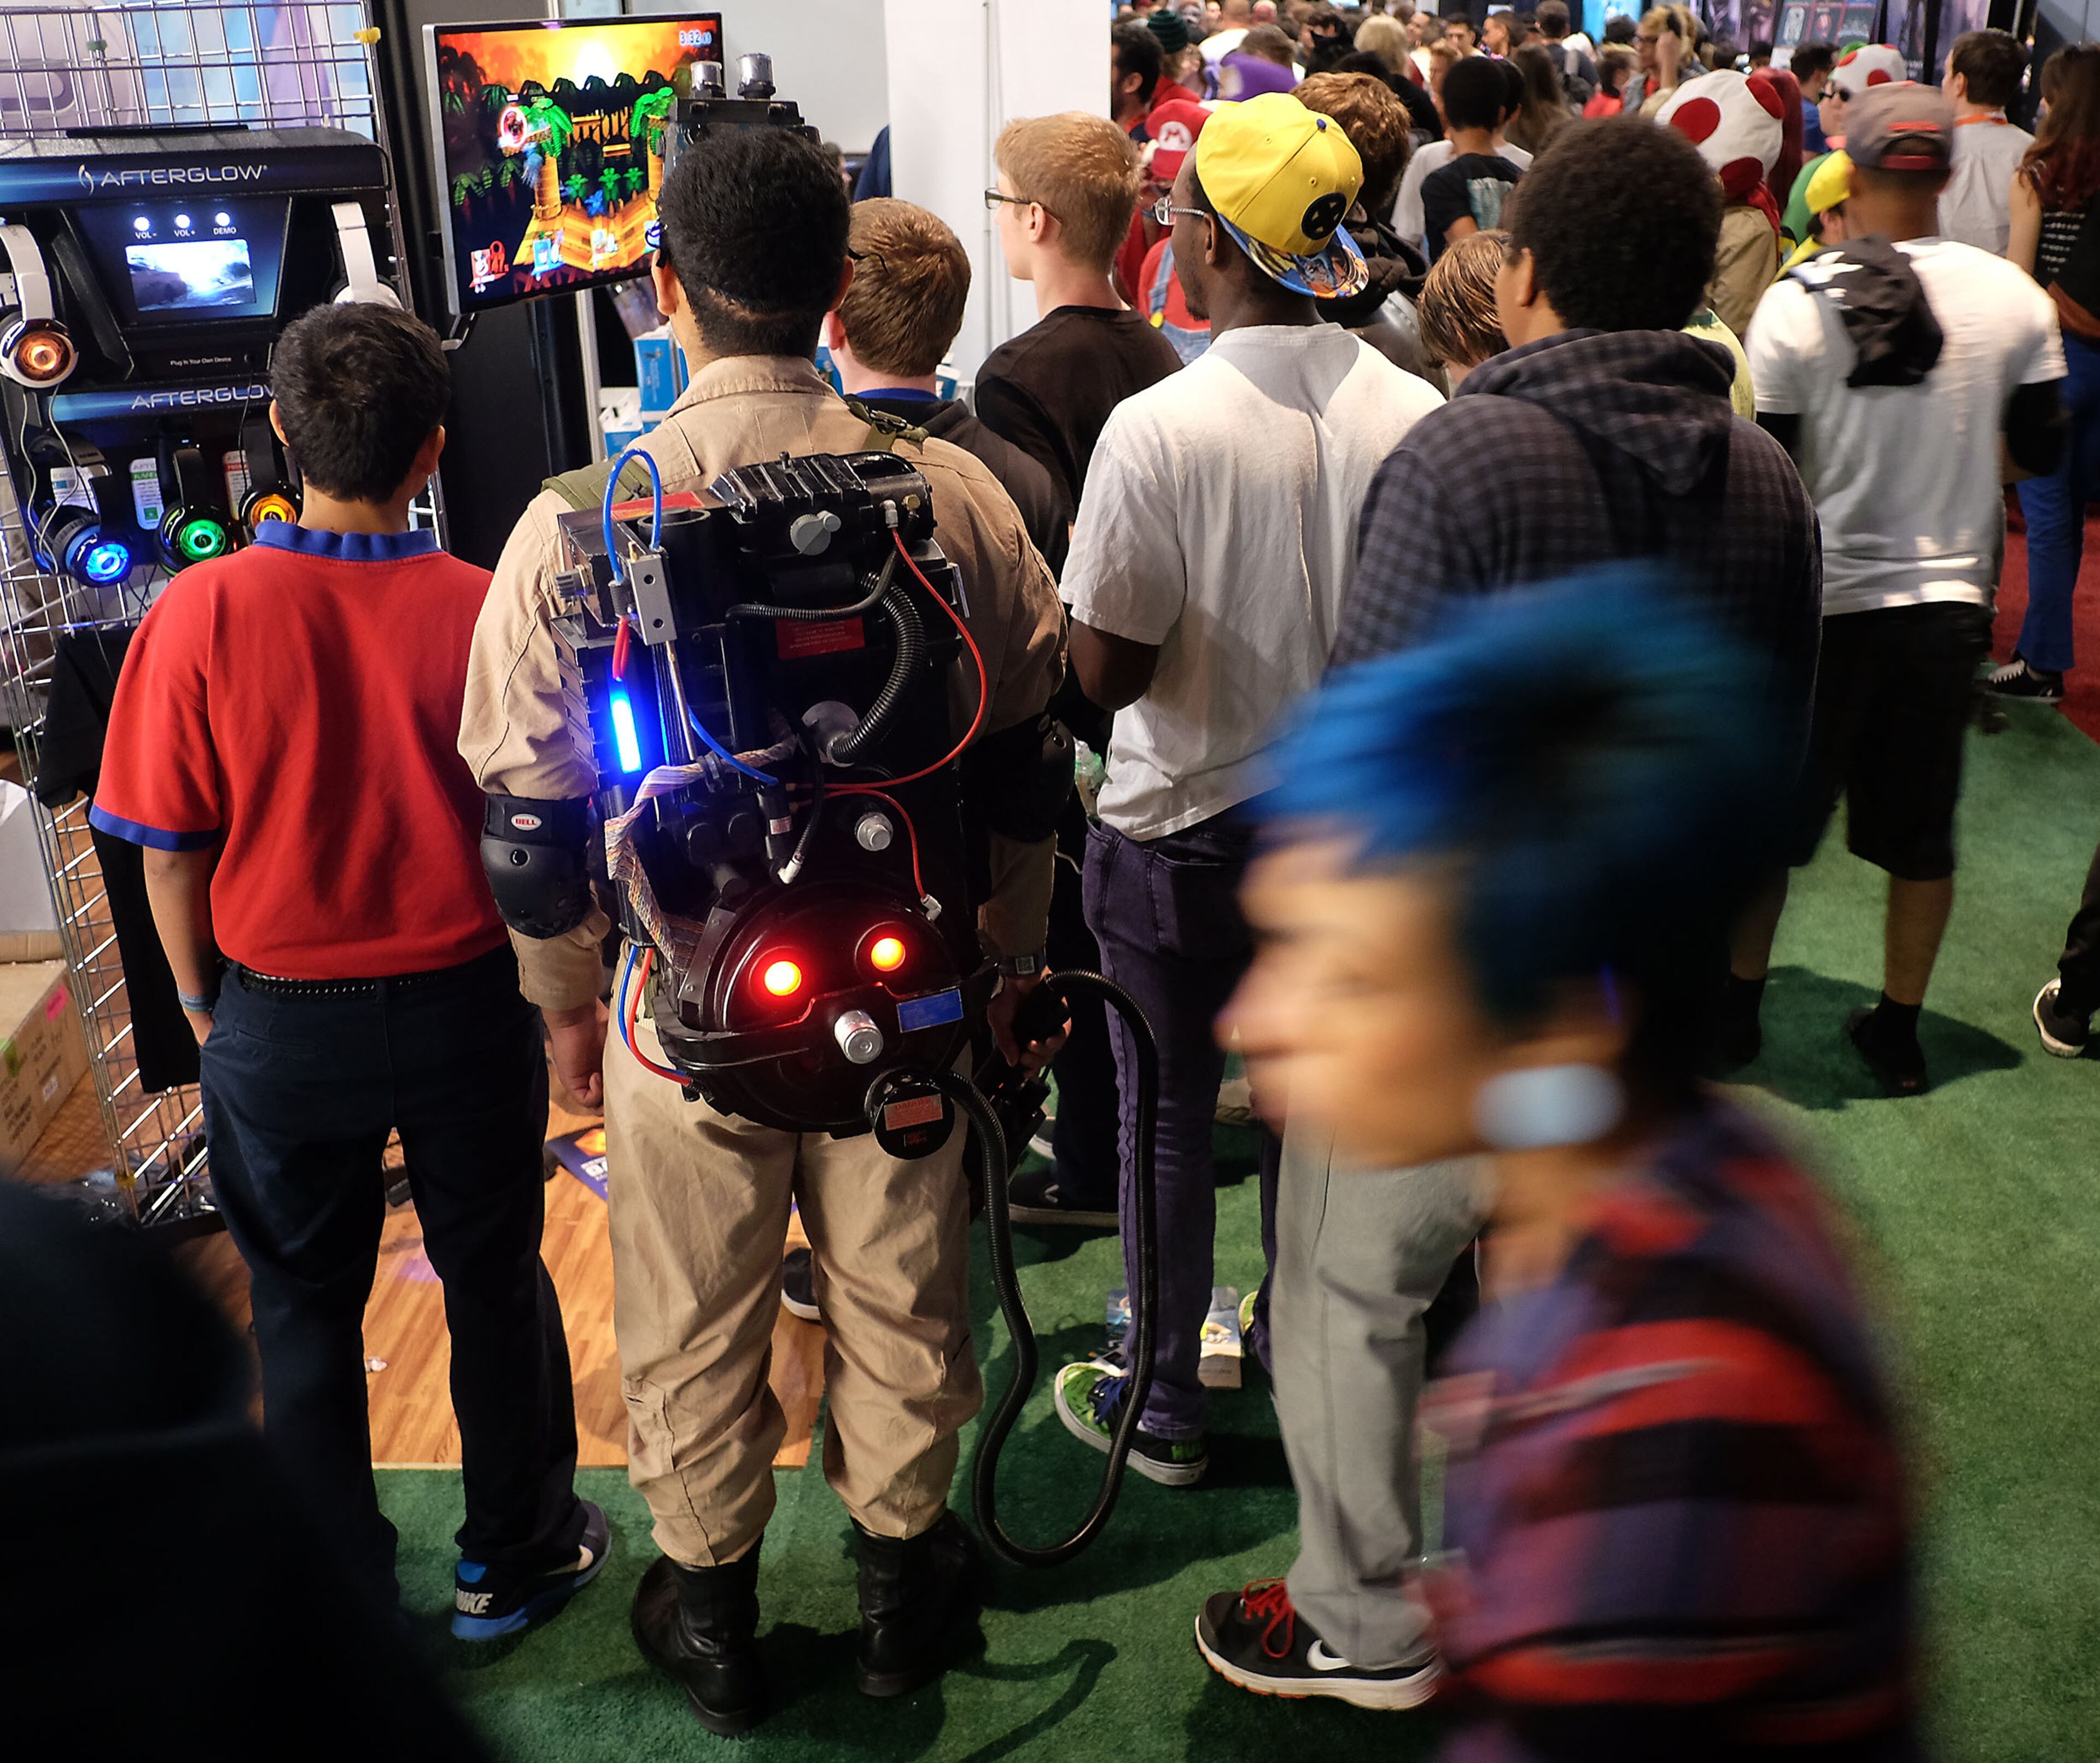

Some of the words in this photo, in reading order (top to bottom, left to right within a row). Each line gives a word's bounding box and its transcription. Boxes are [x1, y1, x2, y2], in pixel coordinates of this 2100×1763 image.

[1164, 128, 1185, 144] M
[101, 165, 262, 187] AFTERGLOW
[515, 818, 537, 826] BELL
[456, 1588, 493, 1614] NIKE
